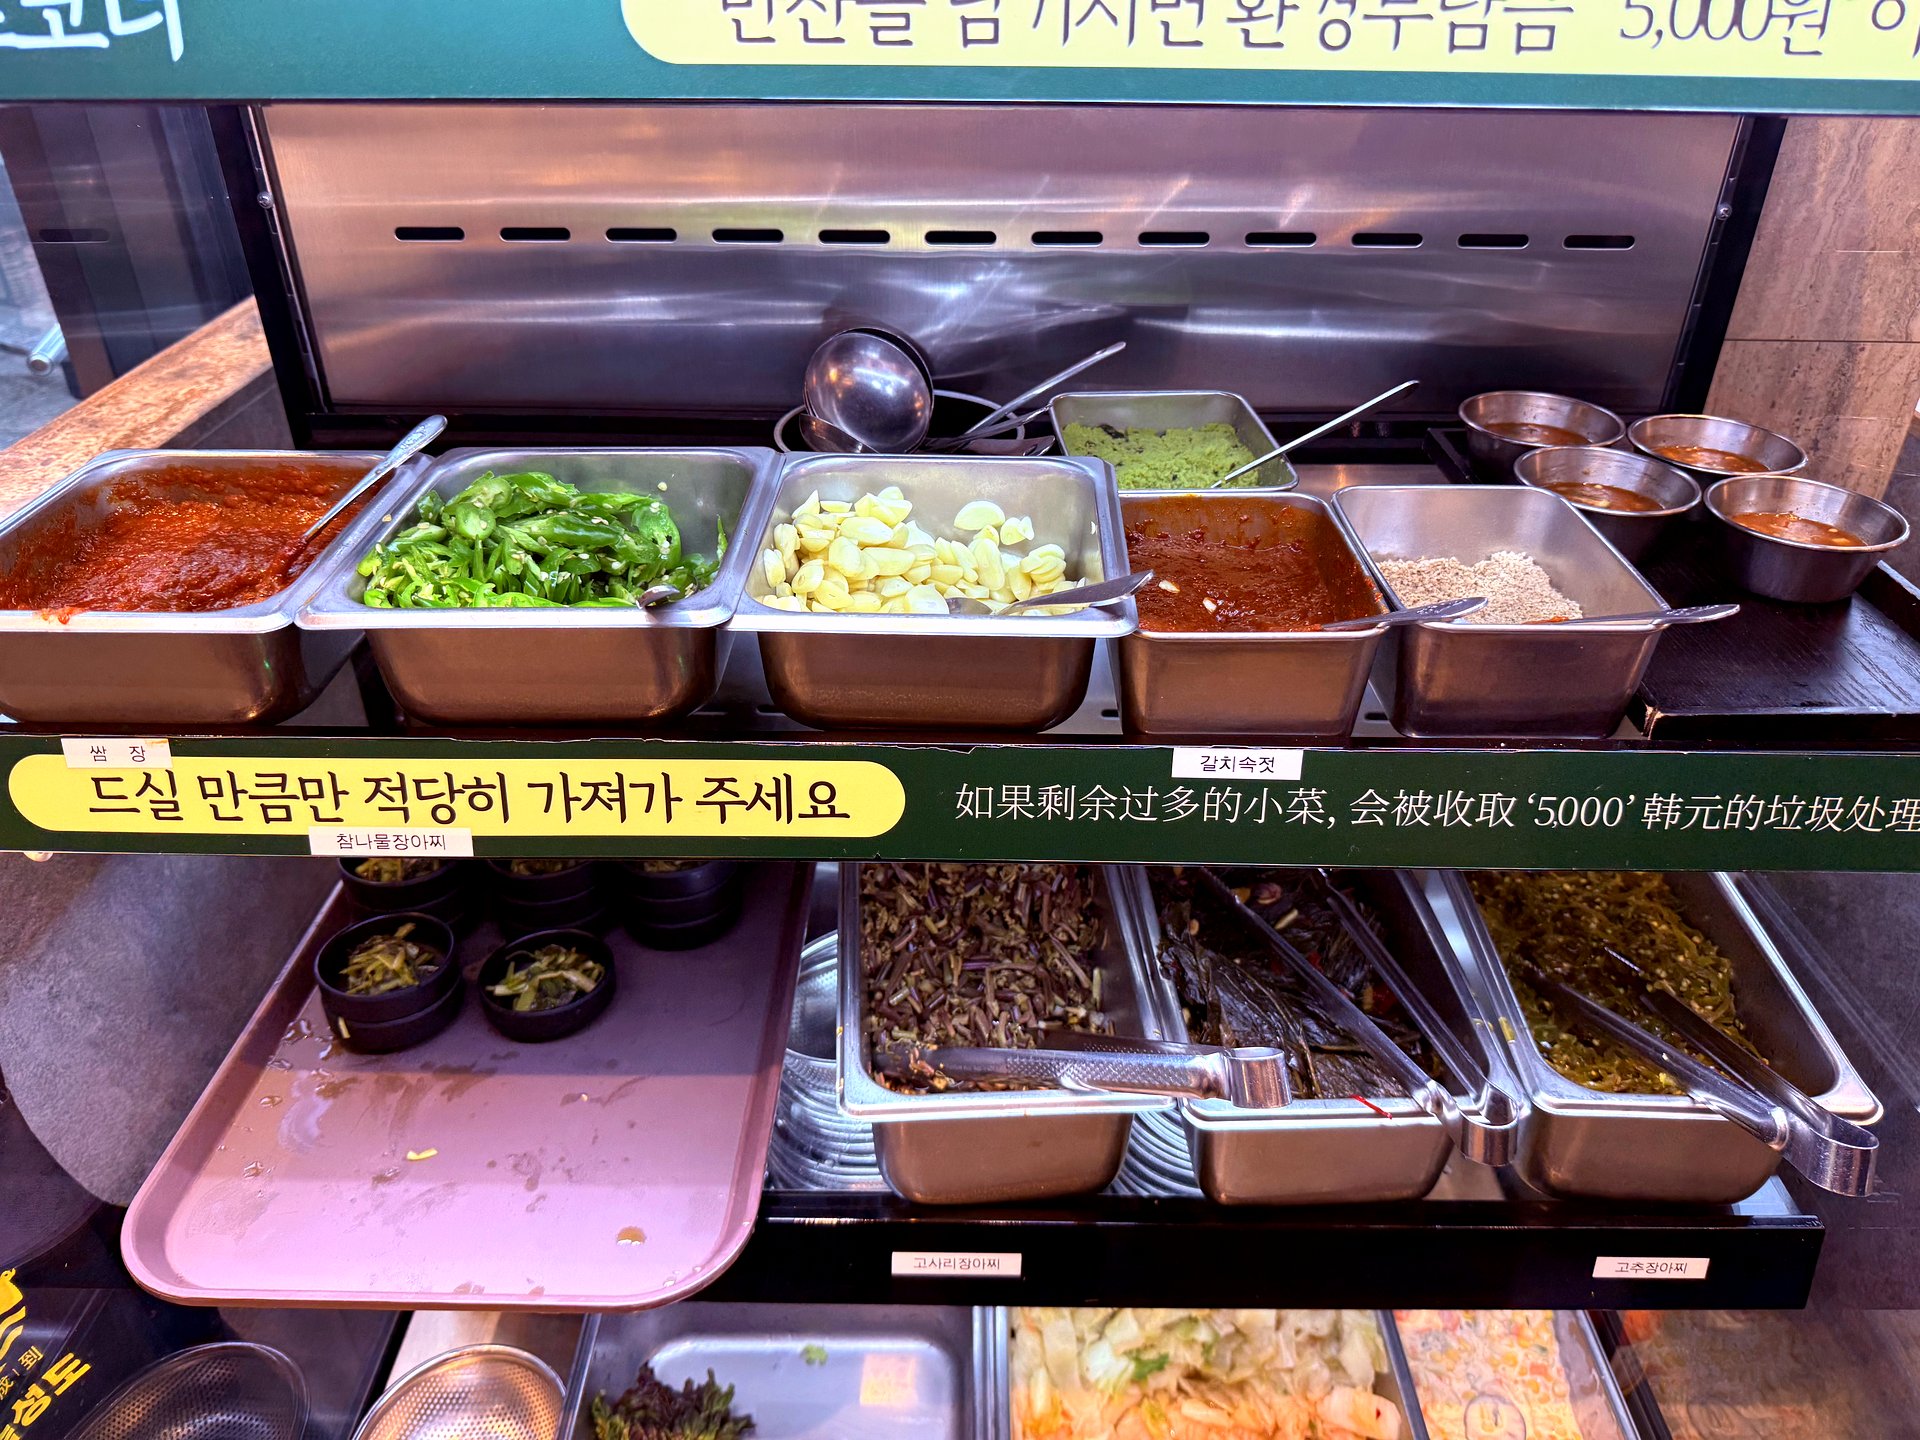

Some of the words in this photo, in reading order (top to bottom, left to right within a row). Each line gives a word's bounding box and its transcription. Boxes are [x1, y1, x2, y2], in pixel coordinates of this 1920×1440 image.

[89, 745, 108, 763] 쌈
[128, 745, 146, 763] 장
[1200, 755, 1276, 774] 갈치속젓
[88, 768, 185, 822] 드실
[196, 769, 351, 825] 만큼만
[363, 770, 511, 826] 적당히
[526, 771, 684, 825] 가져가
[695, 772, 851, 826] 주세요
[954, 782, 1337, 830] 如果剩余过多的小菜,
[1349, 787, 1518, 828] 会被收取
[1640, 791, 1920, 833] 韩元的垃圾处理
[336, 832, 447, 851] 참나물장아찌
[912, 1256, 1001, 1270] 고사리장아찌
[1614, 1261, 1688, 1275] 고추장아찌
